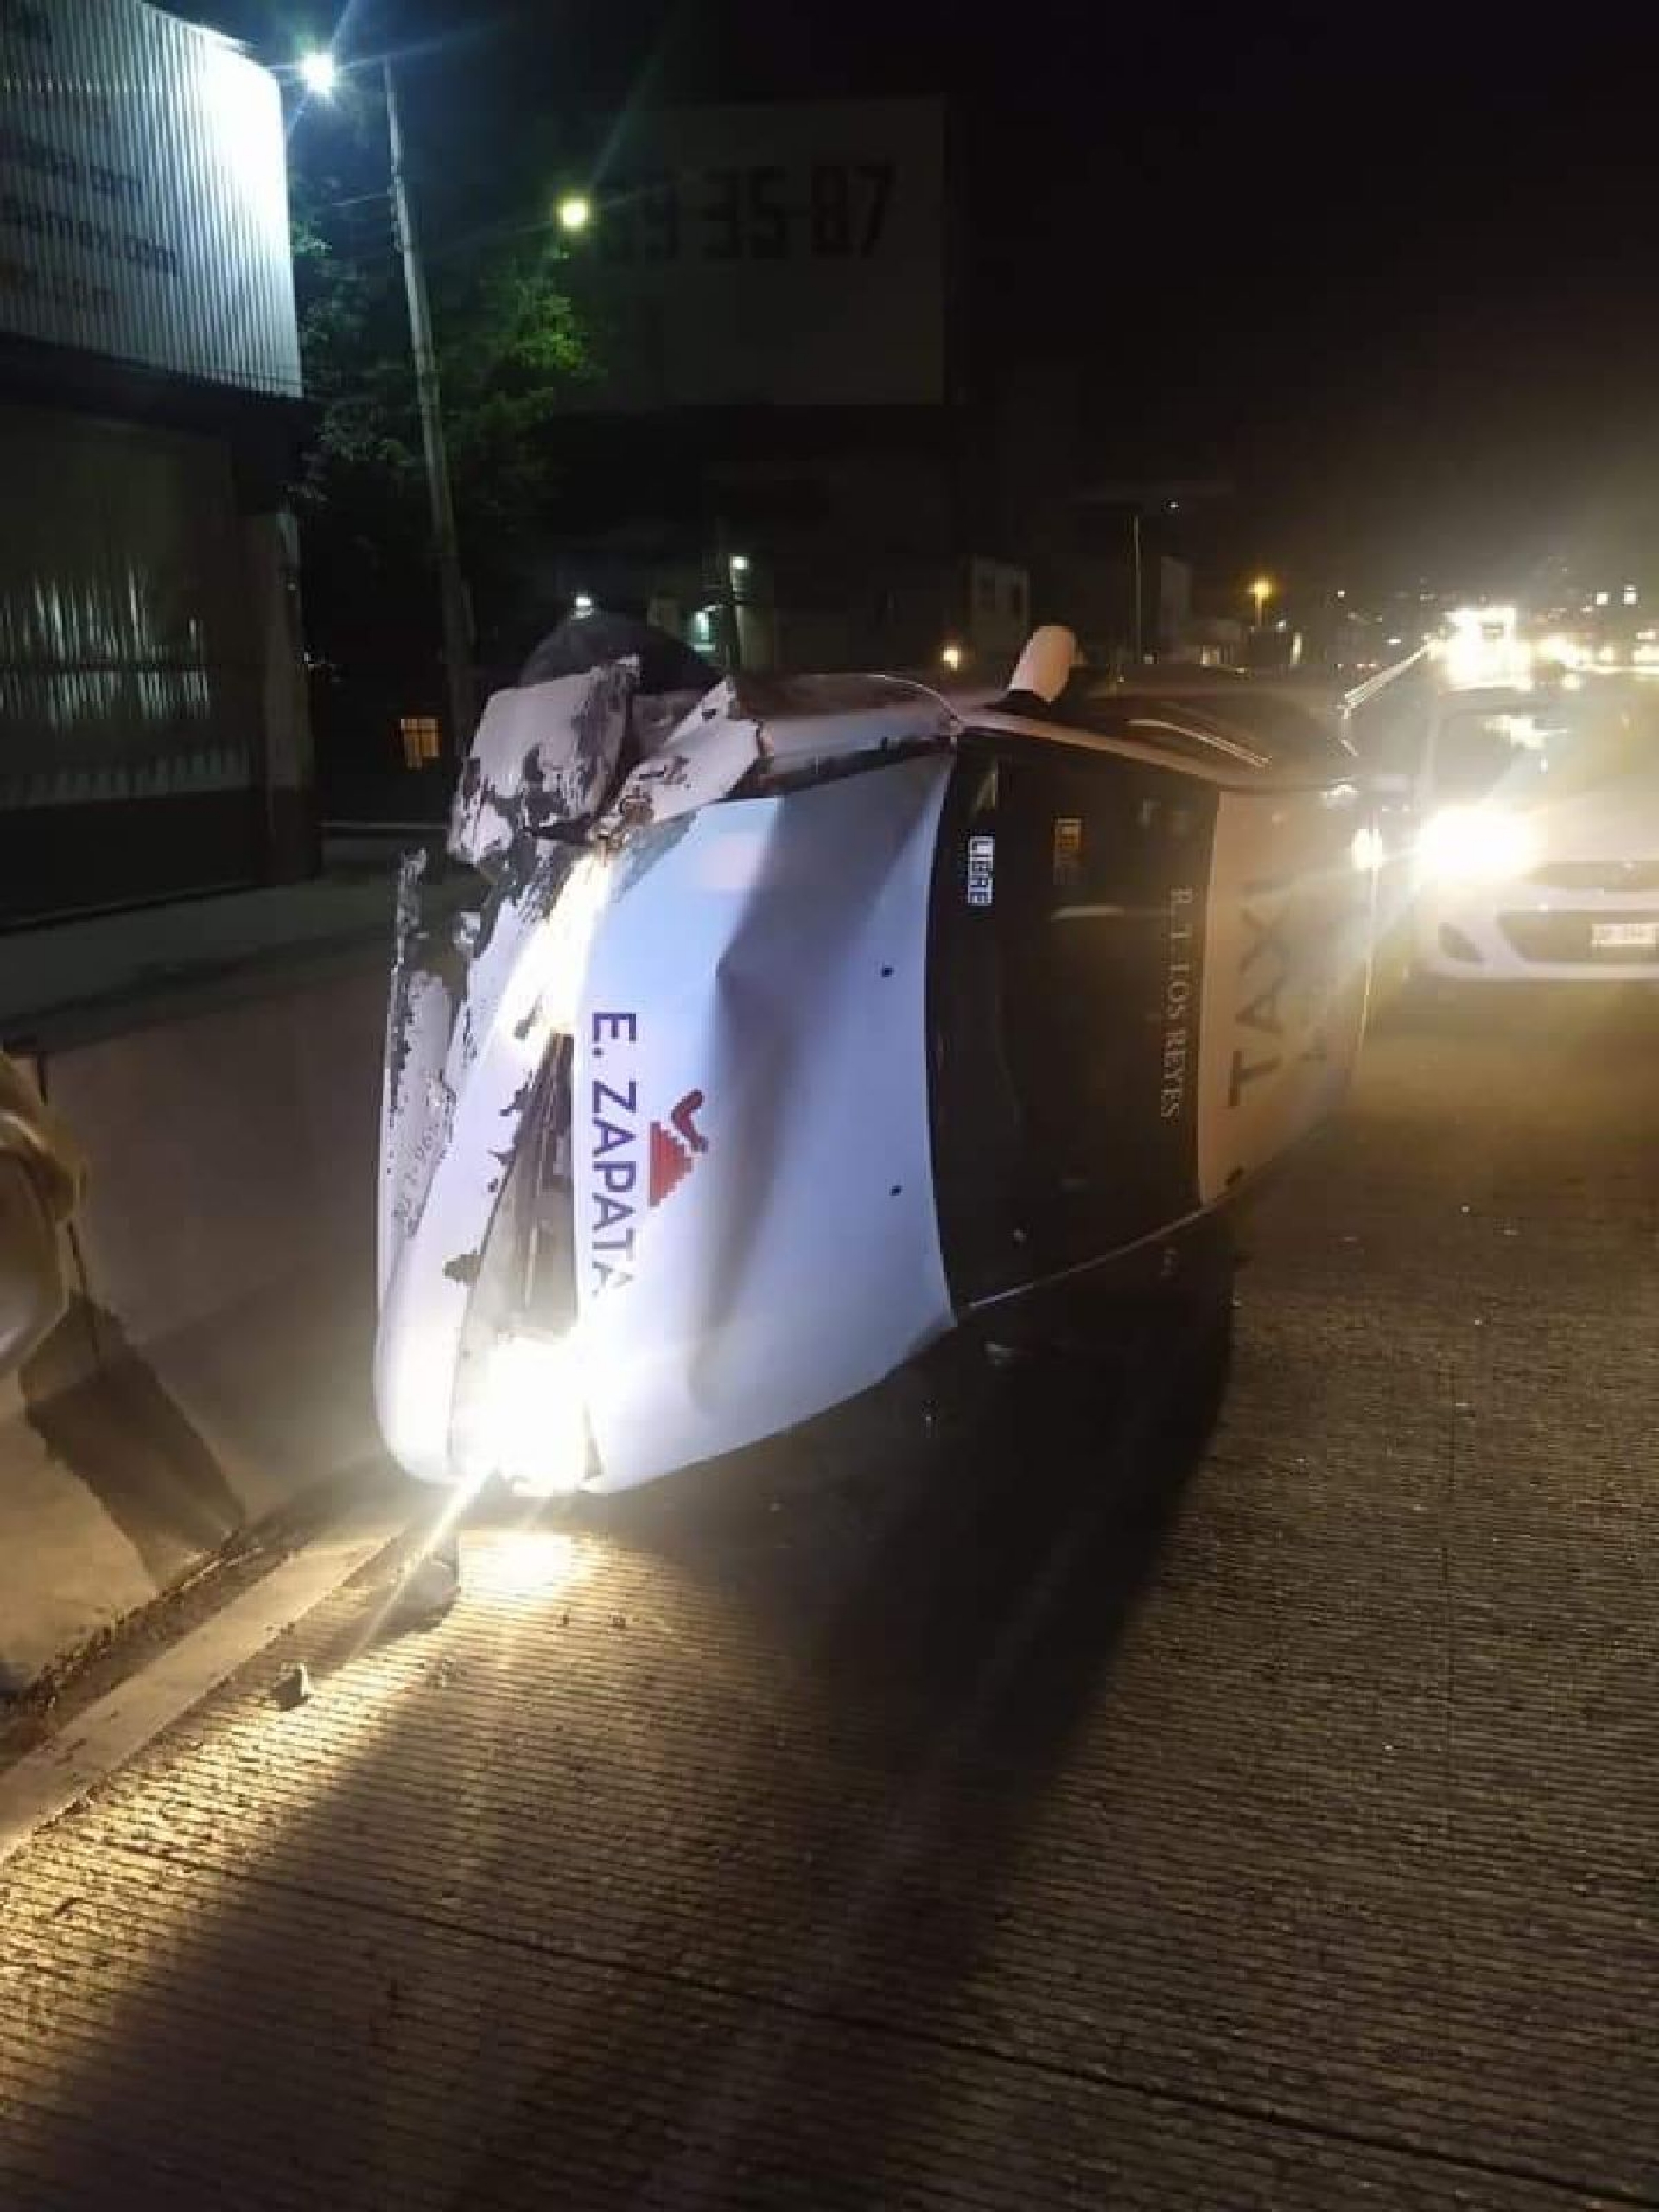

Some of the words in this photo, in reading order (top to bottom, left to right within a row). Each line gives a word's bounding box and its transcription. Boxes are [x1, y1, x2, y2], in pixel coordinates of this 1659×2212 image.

[592, 1012, 637, 1057] E.
[1160, 1028, 1186, 1118] REYES
[592, 1080, 637, 1297] ZAPATA
